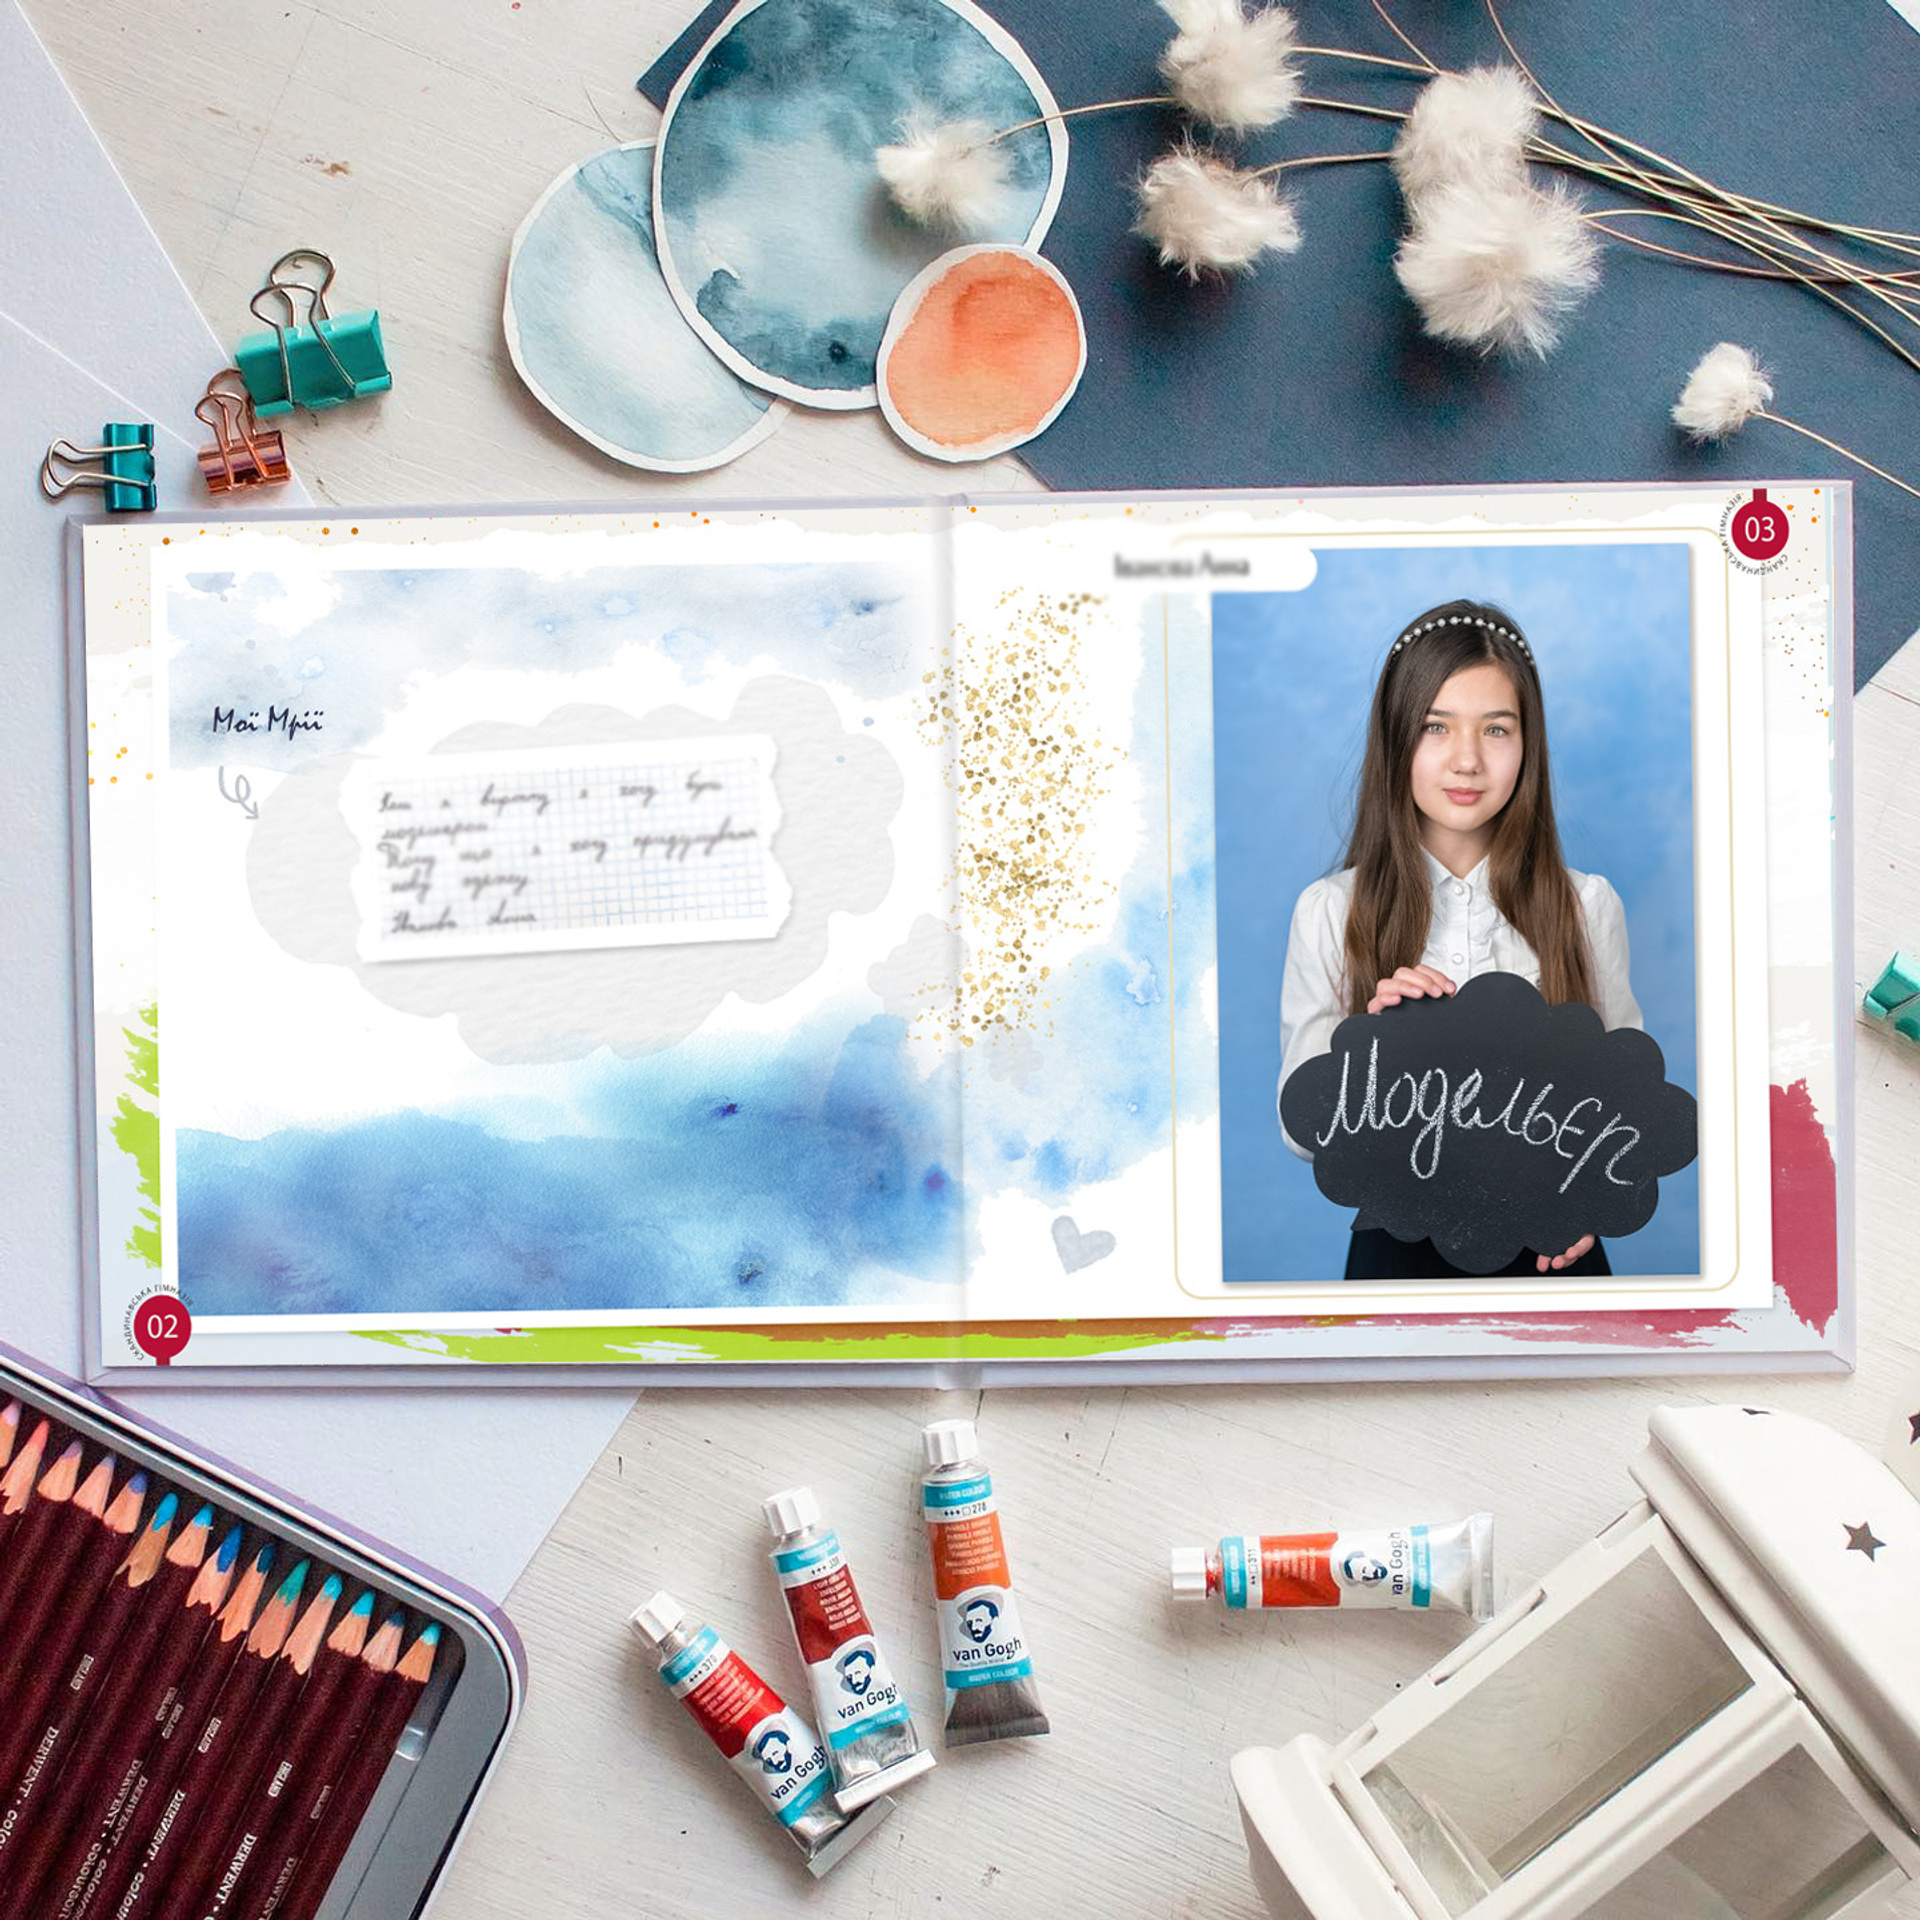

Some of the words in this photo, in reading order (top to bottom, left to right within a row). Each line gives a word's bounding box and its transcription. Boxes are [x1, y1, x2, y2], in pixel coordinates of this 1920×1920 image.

[1745, 516, 1775, 542] 03
[213, 706, 259, 733] Мої
[267, 705, 324, 741] Мрії
[147, 1314, 178, 1339] 02
[1388, 1532, 1408, 1569] Gogh
[952, 1647, 981, 1661] van
[984, 1637, 1022, 1660] Gogh
[837, 1699, 865, 1719] van
[19, 1726, 59, 1798] DERWENT
[770, 1777, 798, 1800] van
[794, 1745, 829, 1779] Gogh
[103, 1760, 143, 1828] DERWENT
[112, 1775, 148, 1846] DERWENT
[147, 1789, 187, 1860] DERWENT
[215, 1833, 258, 1904] DERWENT
